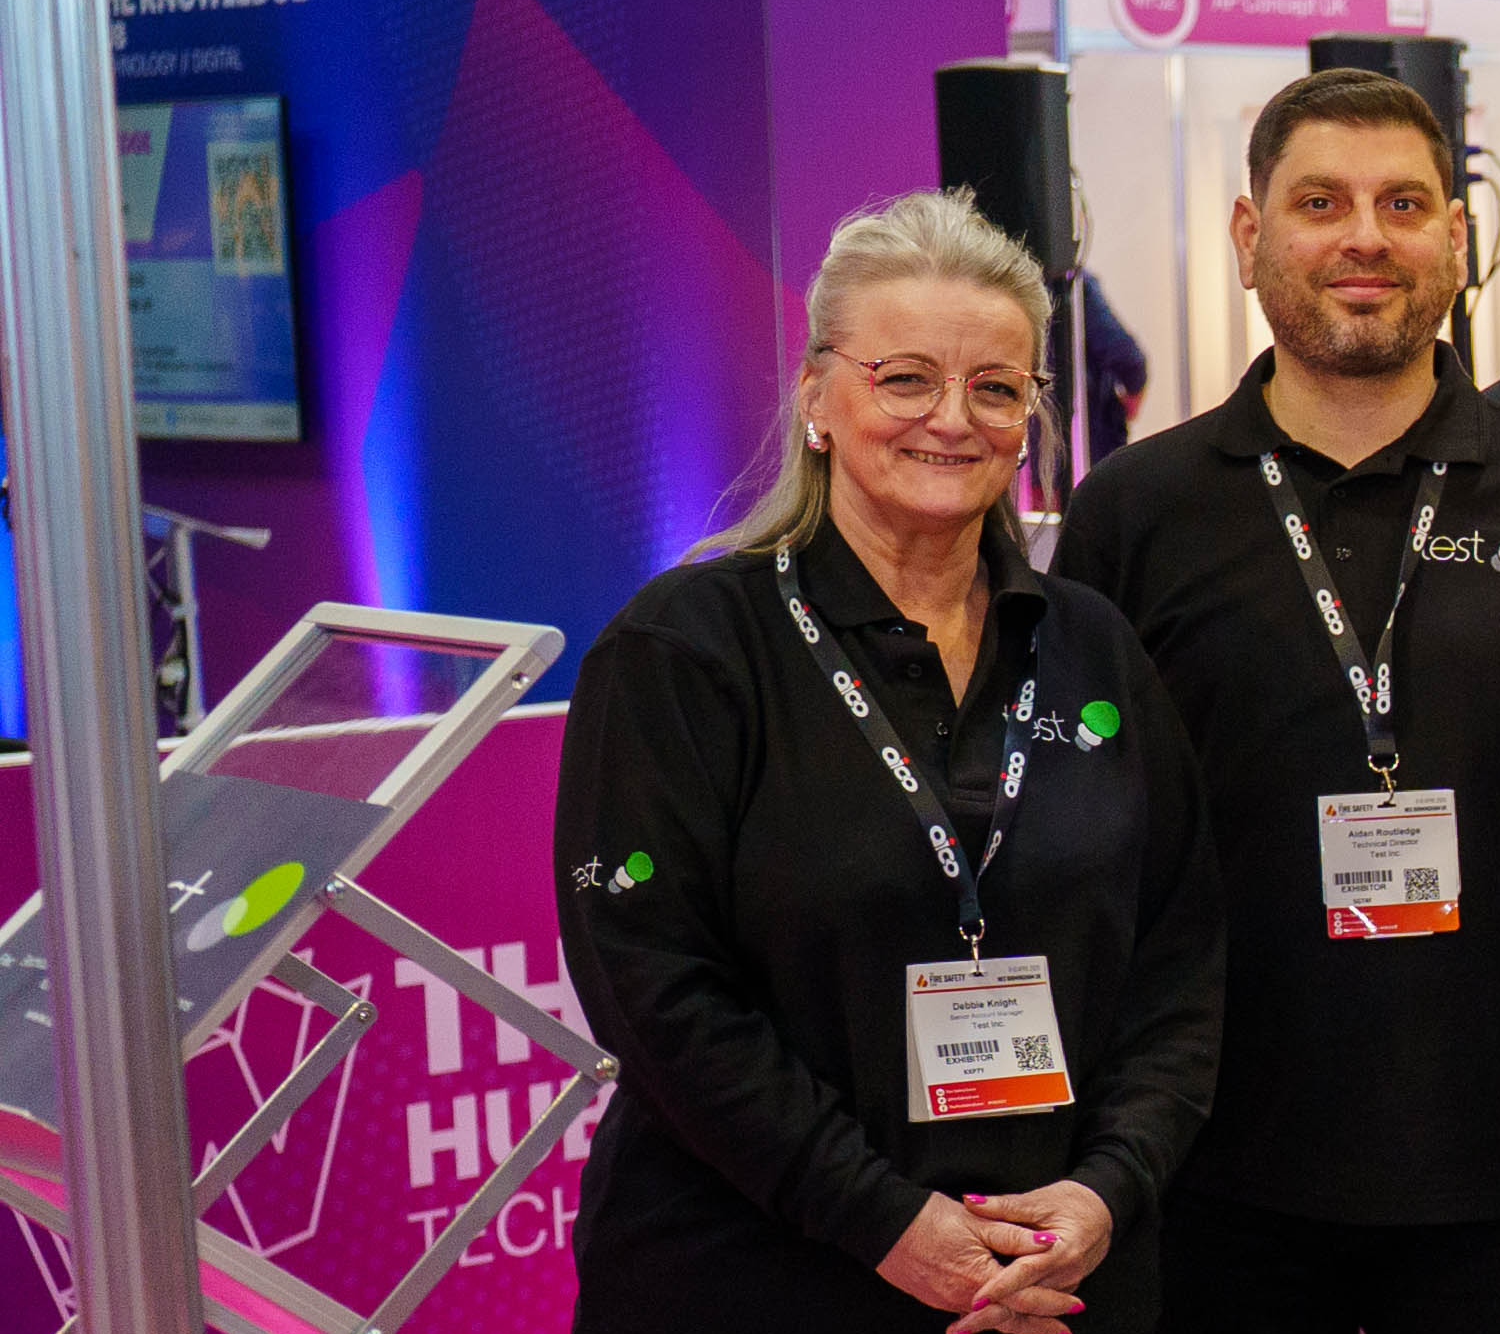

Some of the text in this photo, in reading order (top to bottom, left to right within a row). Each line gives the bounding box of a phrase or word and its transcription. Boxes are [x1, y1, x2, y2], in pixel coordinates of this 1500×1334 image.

[1285, 514, 1311, 560] aico
[1422, 530, 1485, 565] test
[1316, 589, 1344, 636] aico
[833, 670, 869, 717] aico
[881, 747, 918, 792] aico
[1352, 804, 1373, 812] SAFETY
[1348, 828, 1421, 838] Aidan Routledge
[1352, 839, 1418, 848] Technical Director
[929, 825, 959, 877] aico
[1370, 850, 1386, 858] Test
[1341, 884, 1386, 893] EXHIBITOR
[944, 973, 965, 982] SAFETY
[394, 937, 596, 1076] TH
[953, 998, 1017, 1011] Debbie Knight
[946, 1054, 994, 1065] EXHIBITOR
